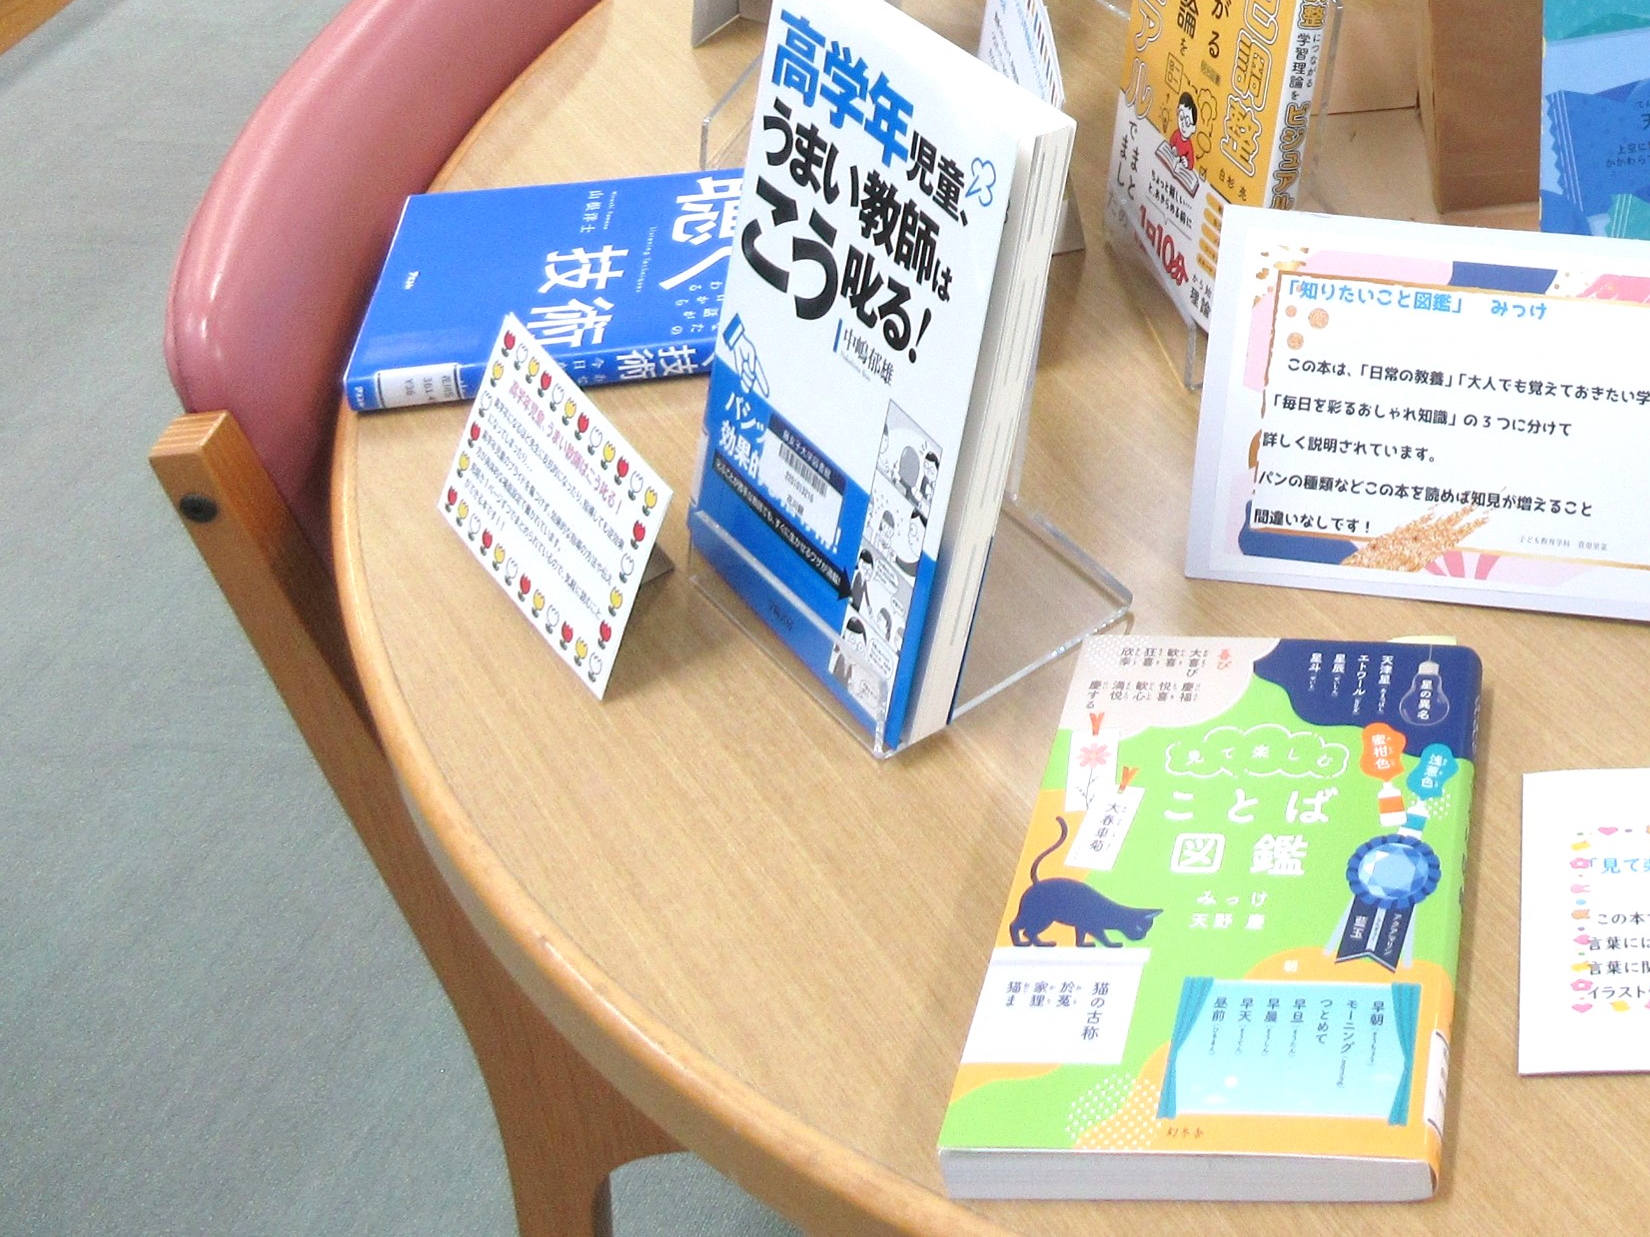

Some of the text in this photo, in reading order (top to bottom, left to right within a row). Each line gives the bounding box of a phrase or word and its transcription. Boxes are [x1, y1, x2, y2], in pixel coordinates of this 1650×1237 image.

[763, 97, 953, 303] うまい教師は
[526, 244, 629, 348] 技術
[1287, 278, 1464, 315] 「知りたいこと図鑑」
[1262, 431, 1438, 463] 詳しく説明されています。
[1257, 469, 1594, 519] パンの種類などこの本を読めば知見が増えること
[1253, 508, 1372, 536] 間違いなしです！
[1353, 654, 1369, 696] エトワール
[1417, 679, 1433, 720] 星の異名
[1186, 744, 1333, 768] 見て楽しむ
[1164, 787, 1339, 824] ことば
[1170, 833, 1309, 875] 図鑑
[1197, 891, 1268, 907] みっけ
[1081, 981, 1110, 1040] 猫の古称
[1315, 998, 1333, 1044] つとめて
[1340, 1000, 1358, 1054] モーニング
